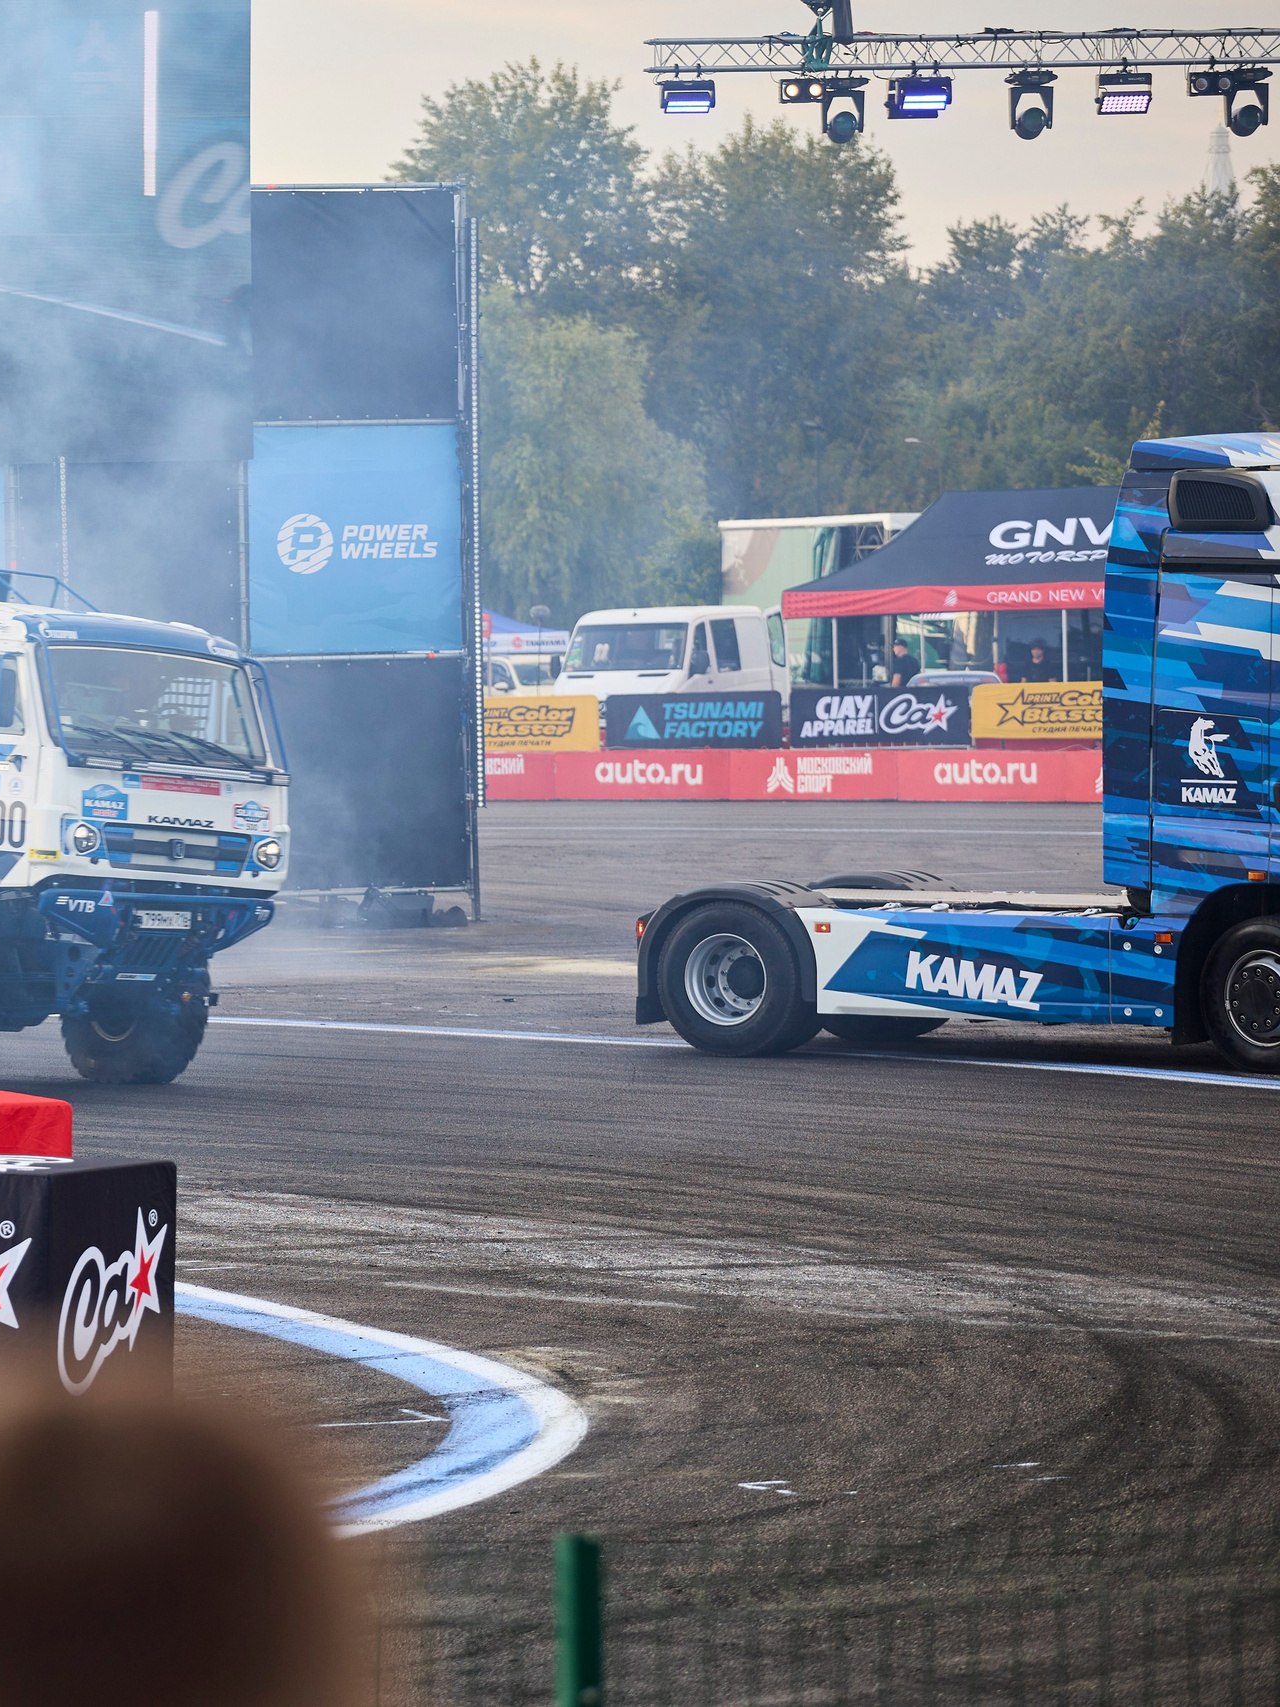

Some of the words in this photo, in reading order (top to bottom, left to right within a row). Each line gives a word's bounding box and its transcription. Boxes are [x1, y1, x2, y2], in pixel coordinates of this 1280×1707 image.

[342, 524, 428, 542] POWER
[989, 517, 1114, 550] GNV
[341, 542, 438, 559] WHEELS
[984, 549, 1108, 566] MOTORSP
[986, 591, 1041, 604] GRAND
[1049, 589, 1084, 602] NEW
[1059, 690, 1102, 707] Col
[510, 706, 575, 721] Color
[662, 702, 764, 720] TSUNAMI
[663, 721, 764, 738] FACTORY
[800, 719, 874, 738] APPAREL
[485, 754, 525, 775] ВСКИЙ
[595, 760, 703, 785] auto.ru
[797, 753, 873, 776] МОСКОВСКИЙ
[933, 759, 1037, 784] auto.ru
[797, 775, 833, 793] СПОРТ
[1181, 786, 1237, 804] KAMAZ
[148, 815, 214, 829] KAMAZ
[69, 899, 95, 913] VTB
[905, 950, 1044, 1011] KAMAZ
